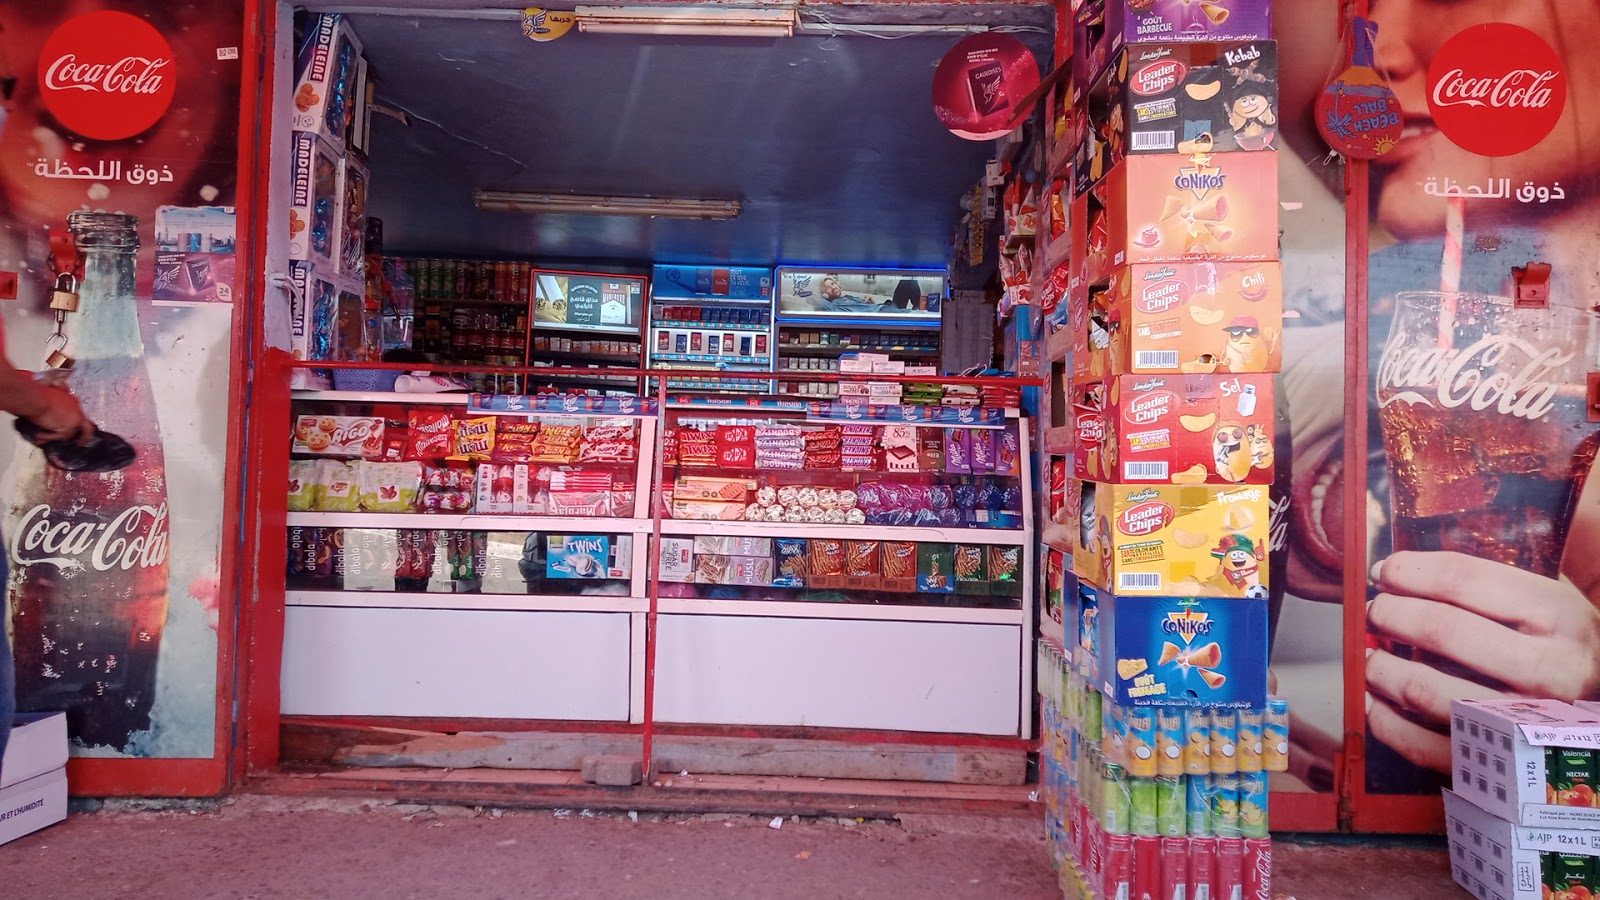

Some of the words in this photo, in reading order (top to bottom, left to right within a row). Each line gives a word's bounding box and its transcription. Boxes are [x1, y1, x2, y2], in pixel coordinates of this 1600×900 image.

[1136, 23, 1173, 34] BARBECUE
[1142, 16, 1163, 25] GOÛT
[311, 17, 334, 82] MADELEINE
[1225, 45, 1261, 66] Kebab
[45, 54, 170, 94] Coca-Cola
[1138, 63, 1177, 83] Leader
[1143, 74, 1175, 92] Chips
[1433, 68, 1559, 108] Coca-Cola
[1353, 98, 1389, 116] BALL
[1353, 112, 1400, 132] BEACH
[34, 158, 121, 181] اللحظة
[126, 164, 174, 186] ذوق
[295, 139, 310, 206] MADELEINE
[1424, 177, 1510, 199] اللحظة
[1516, 181, 1565, 203] ذوق
[1242, 272, 1265, 288] Chili
[1142, 283, 1180, 302] Leader
[1146, 293, 1179, 311] Chips
[1220, 378, 1242, 397] Sel
[1131, 394, 1169, 414] Leader
[1136, 405, 1168, 423] Chips
[331, 425, 370, 444] RIGO
[595, 429, 616, 437] bueno
[683, 443, 718, 456] TWIX
[763, 460, 797, 468] BOUNTY
[1216, 489, 1262, 505] Fromage
[1124, 504, 1164, 523] Leader
[1129, 515, 1162, 533] Chips
[12, 502, 169, 571] Coca-Cola
[7, 810, 13, 819] ET
[1537, 833, 1552, 843] AJP
